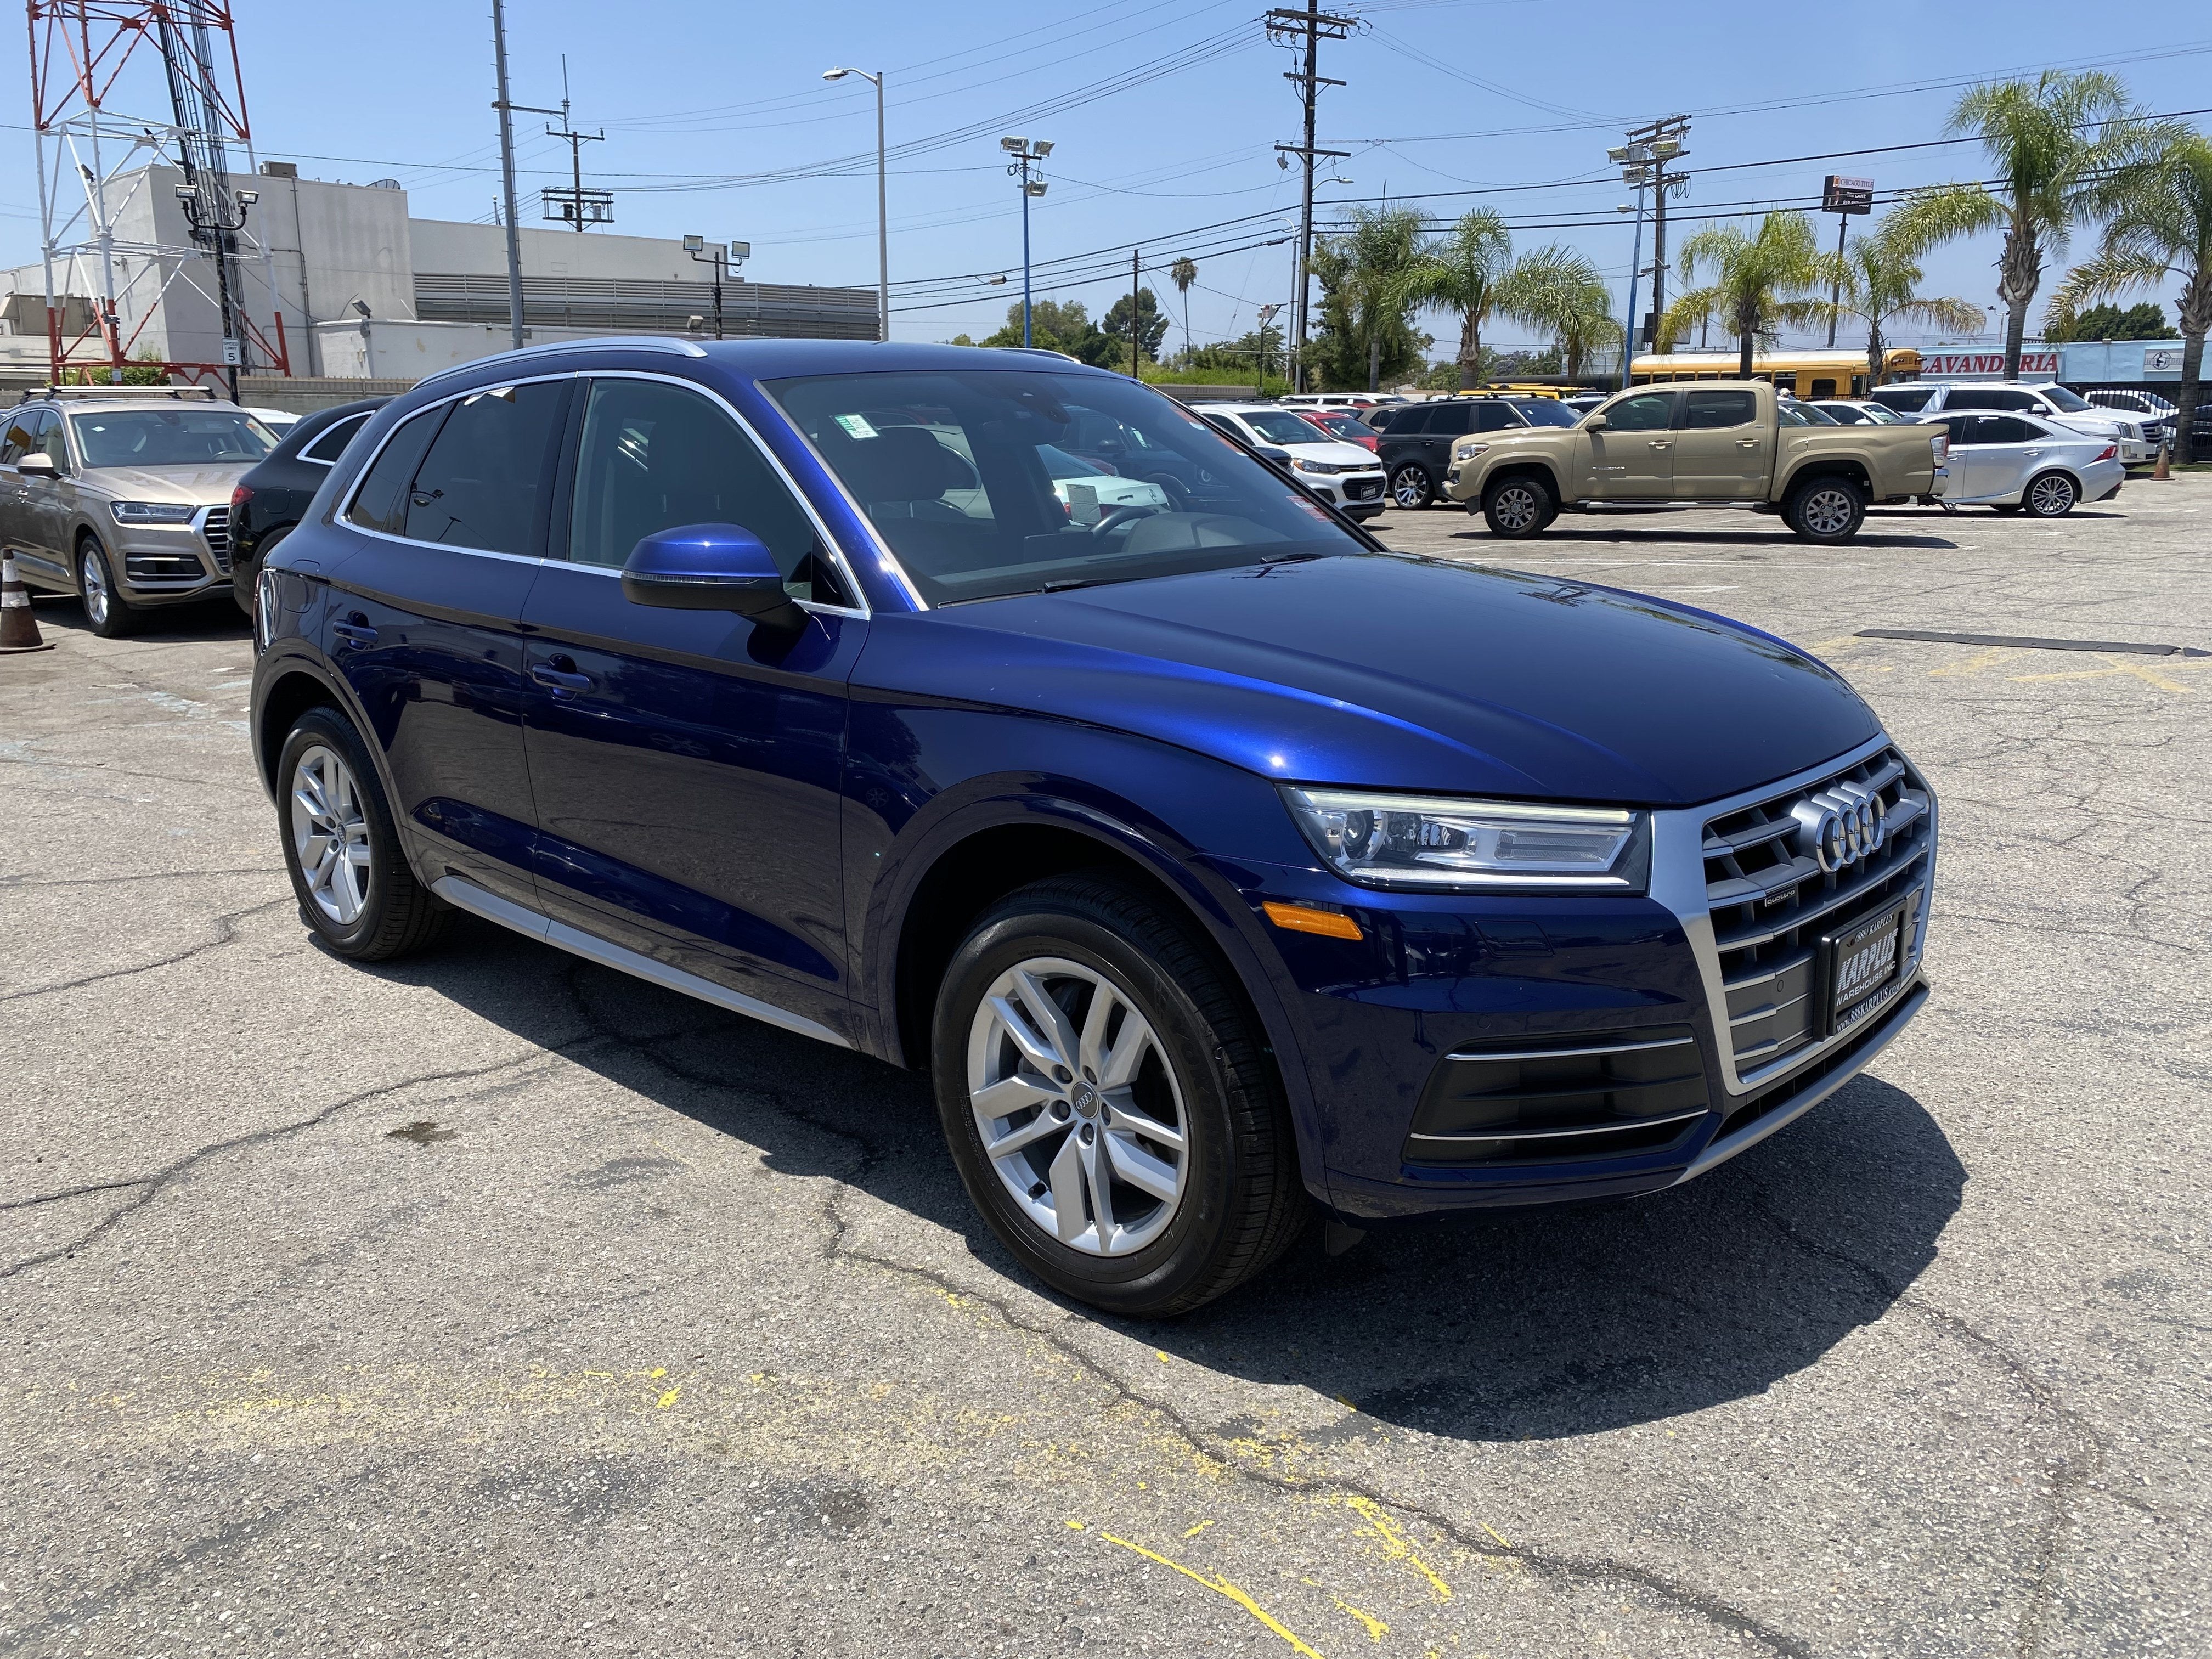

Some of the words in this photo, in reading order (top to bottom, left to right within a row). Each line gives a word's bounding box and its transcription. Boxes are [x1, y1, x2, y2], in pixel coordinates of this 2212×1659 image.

[1841, 178, 1861, 187] CHICAGO
[228, 353, 235, 362] 5
[1920, 354, 2058, 373] AVANDRIA
[1767, 890, 1795, 905] quattro
[1869, 912, 1894, 935] KARPLUS
[1837, 928, 1899, 994] KARPLUS
[1884, 960, 1896, 975] INC
